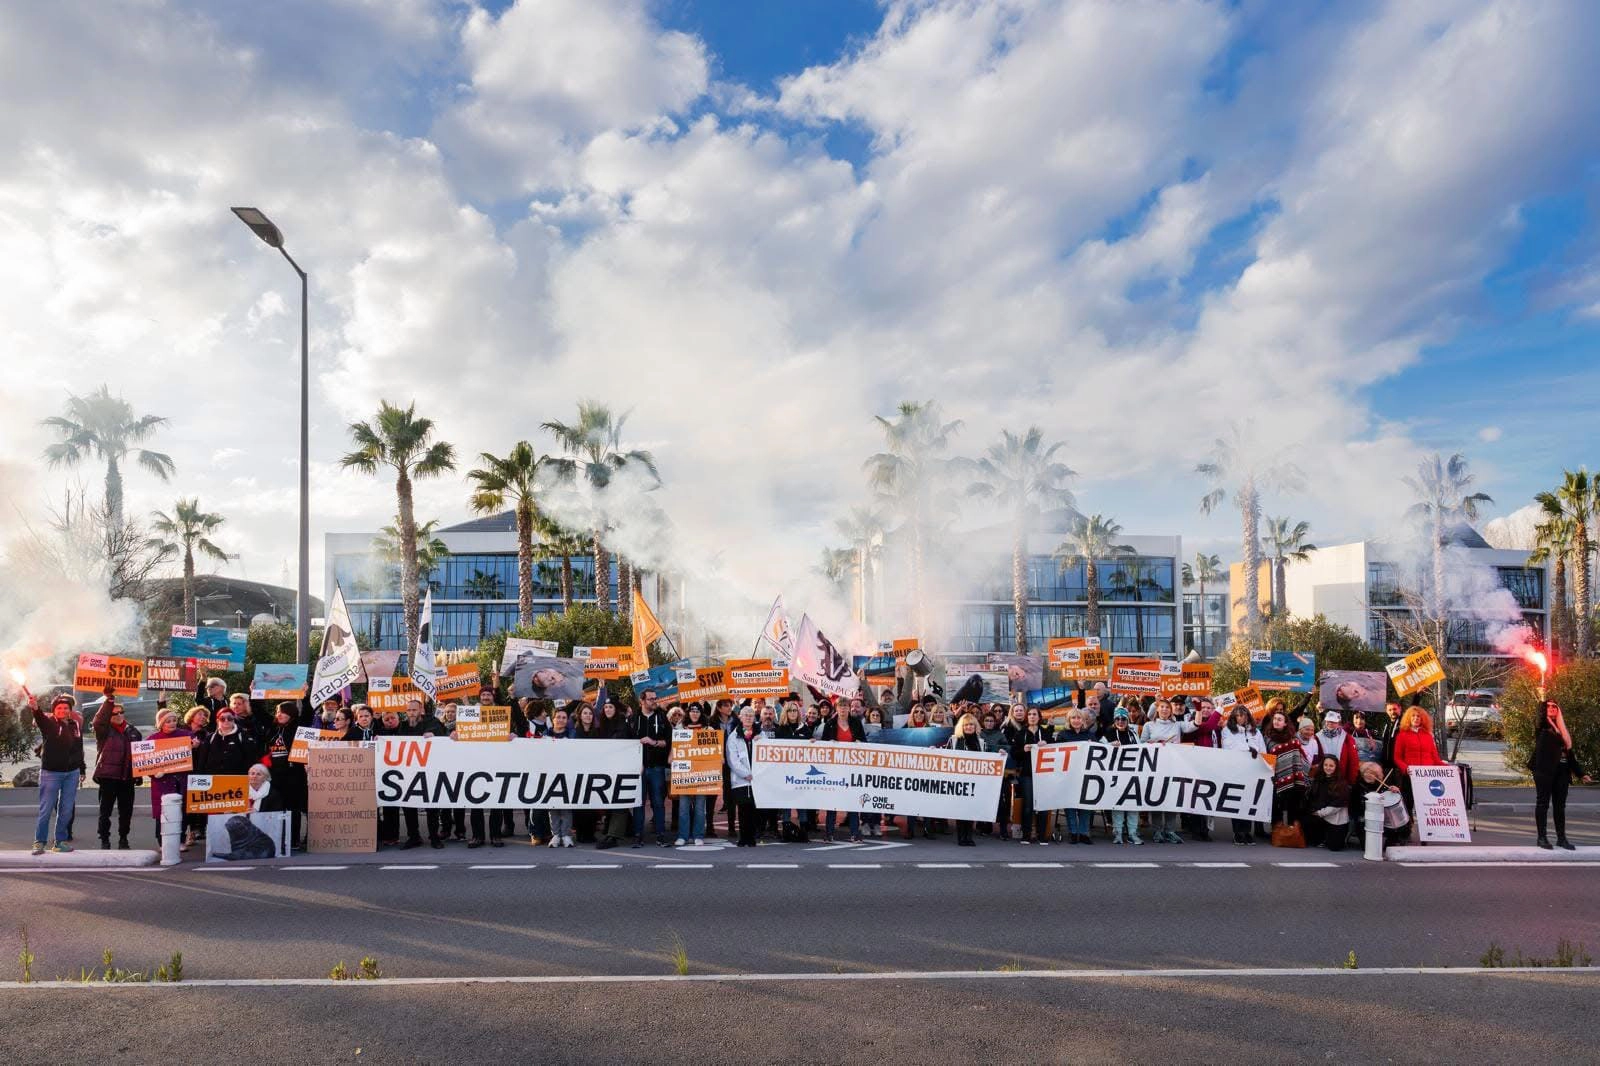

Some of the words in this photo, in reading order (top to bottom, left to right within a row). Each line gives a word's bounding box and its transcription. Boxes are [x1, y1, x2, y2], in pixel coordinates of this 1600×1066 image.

[162, 660, 176, 668] SUIS
[1408, 660, 1417, 672] NI
[109, 664, 141, 678] STOP
[148, 668, 158, 680] LA
[159, 668, 180, 680] VOIX
[1062, 667, 1074, 678] la
[1076, 668, 1103, 677] mer
[1104, 665, 1108, 676] !
[1397, 678, 1409, 692] NI
[1406, 661, 1440, 687] BASSIN
[76, 676, 139, 688] DELPHINARIUM
[148, 680, 160, 689] DES
[160, 680, 186, 689] ANIMAUX
[698, 670, 724, 687] STOP
[802, 673, 818, 684] Sans
[820, 680, 834, 690] Voix
[393, 684, 400, 693] NI
[680, 684, 727, 700] DELPHINARIUM
[1162, 680, 1205, 692] l'océan
[1206, 680, 1210, 690] !
[370, 696, 382, 708] NI
[384, 692, 422, 708] BASSIN
[458, 722, 487, 732] L'océan
[489, 723, 508, 732] pour
[471, 730, 509, 740] dauphins
[156, 750, 192, 764] D'AUTRE
[383, 740, 432, 767] UN
[672, 747, 686, 758] la
[688, 746, 716, 757] mer
[718, 744, 722, 754] !
[318, 754, 364, 764] MARINELAND
[834, 748, 876, 766] MASSIF
[878, 752, 939, 772] D'ANIMAUX
[940, 758, 956, 772] EN
[958, 759, 995, 775] COURS
[1035, 746, 1078, 774] ET
[1085, 746, 1159, 772] RIEN
[312, 769, 320, 778] LE
[320, 768, 344, 778] MONDE
[348, 768, 376, 778] ENTIER
[1415, 769, 1455, 778] KLAXONNEZ
[378, 770, 640, 804] SANCTUAIRE
[672, 777, 690, 785] RIEN
[786, 775, 848, 790] Marineland,
[850, 774, 862, 787] LA
[865, 774, 902, 790] PURGE
[904, 777, 969, 796] COMMENCE
[970, 782, 976, 796] !
[192, 788, 243, 802] Liberté
[1080, 774, 1246, 814] D'AUTRE
[1248, 778, 1266, 816] !
[200, 800, 246, 810] animaux
[1438, 798, 1456, 807] POUR
[1430, 808, 1452, 816] CAUSE
[1426, 818, 1460, 827] ANIMAUX
[324, 824, 336, 834] ON
[339, 824, 358, 834] VEUT
[321, 838, 370, 848] SANCTUAIRE
